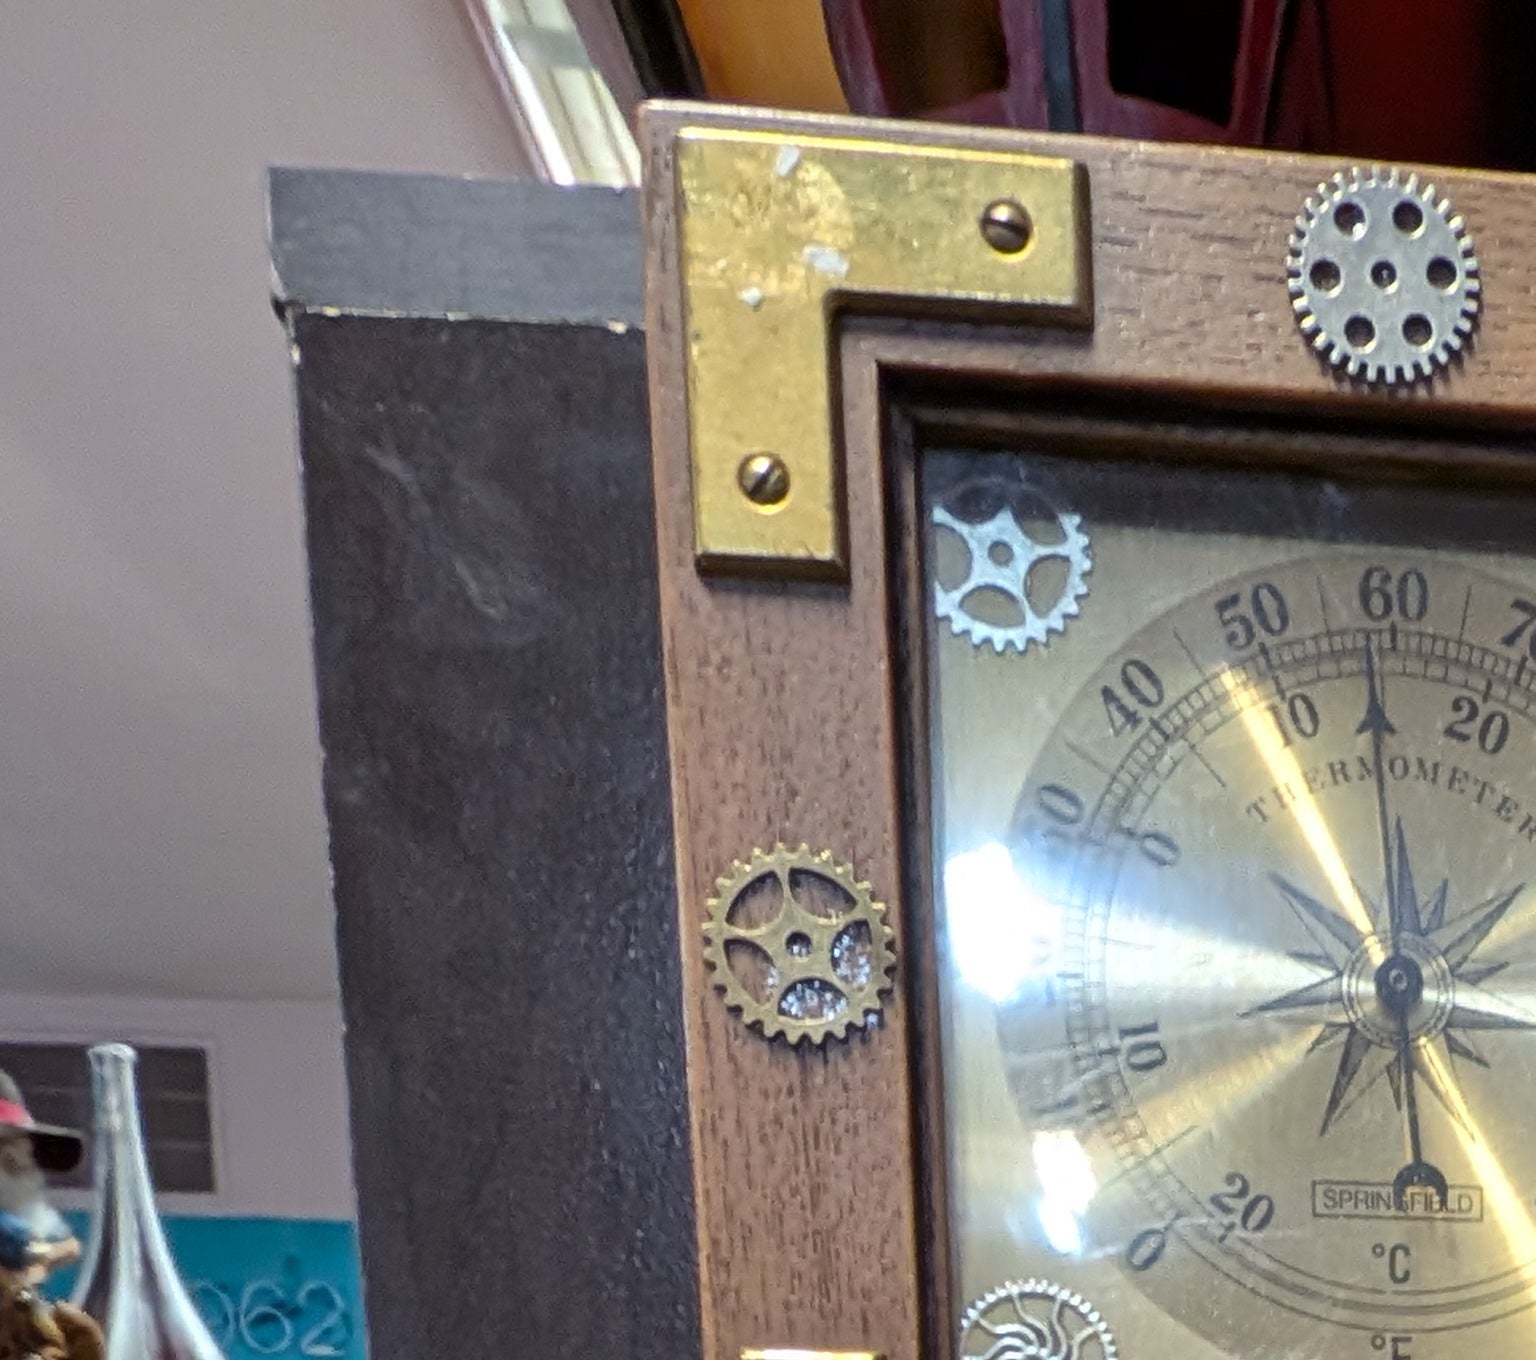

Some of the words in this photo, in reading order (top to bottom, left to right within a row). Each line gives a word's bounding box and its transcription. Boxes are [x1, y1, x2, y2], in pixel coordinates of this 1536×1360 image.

[1214, 582, 1289, 650] 50
[1358, 565, 1429, 623] 60
[1101, 659, 1165, 738] 40
[1266, 691, 1320, 749] 10
[1443, 695, 1511, 756] 20
[1118, 1022, 1168, 1072] 10
[1209, 1171, 1275, 1233] 20
[1124, 1228, 1167, 1272] 0
[1371, 1242, 1412, 1285] °C
